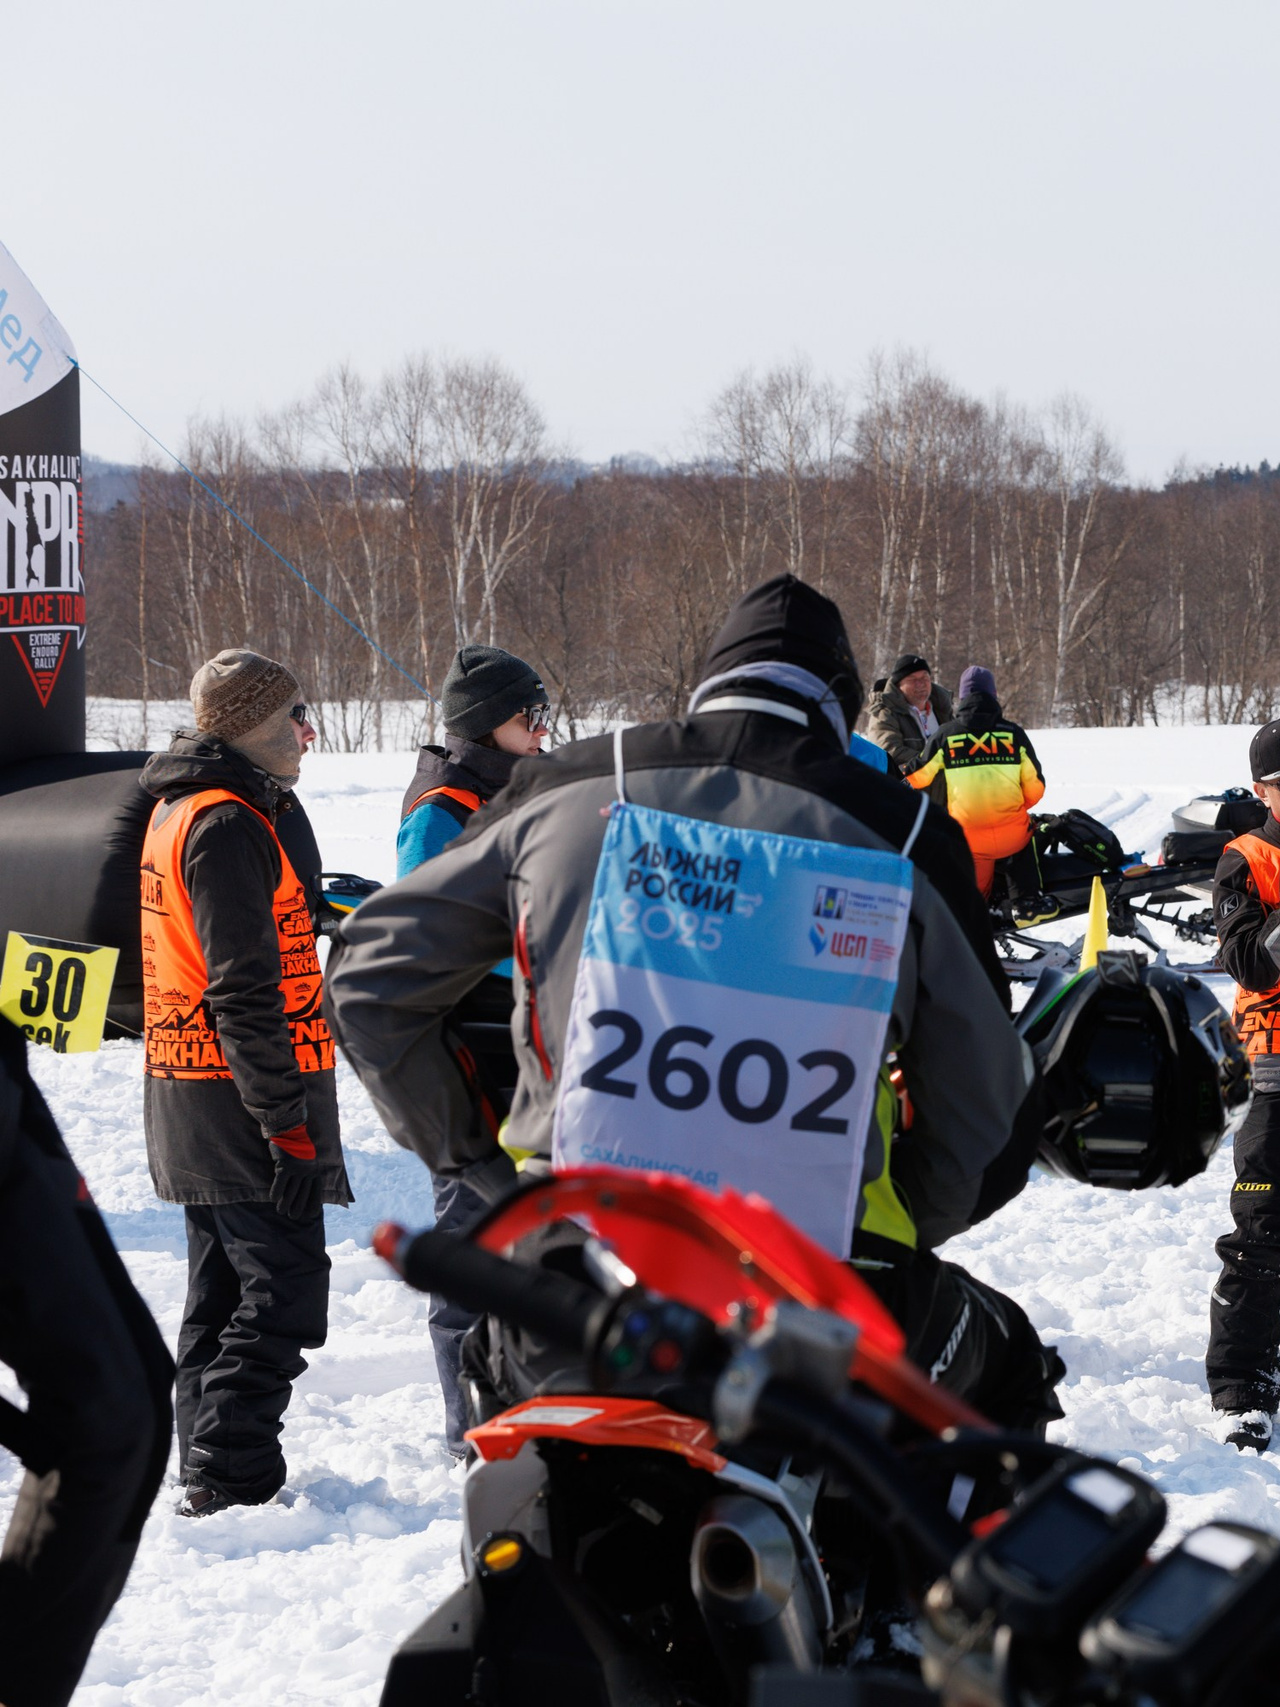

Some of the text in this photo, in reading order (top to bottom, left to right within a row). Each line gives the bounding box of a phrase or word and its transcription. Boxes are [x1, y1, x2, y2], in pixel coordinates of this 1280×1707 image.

[0, 594, 54, 626] PLACE
[57, 594, 72, 623] TO
[29, 632, 61, 646] EXTREME
[31, 646, 59, 658] ENDURO
[34, 657, 57, 669] RALLY
[947, 731, 1015, 758] FXR
[628, 841, 742, 885] ЛЫЖНЯ
[624, 868, 737, 914] РОССИИ
[614, 898, 724, 951] 2025
[830, 931, 868, 959] ЦСП
[19, 951, 87, 1022] 30
[151, 1027, 215, 1043] ENDURO
[580, 1009, 856, 1135] 2602
